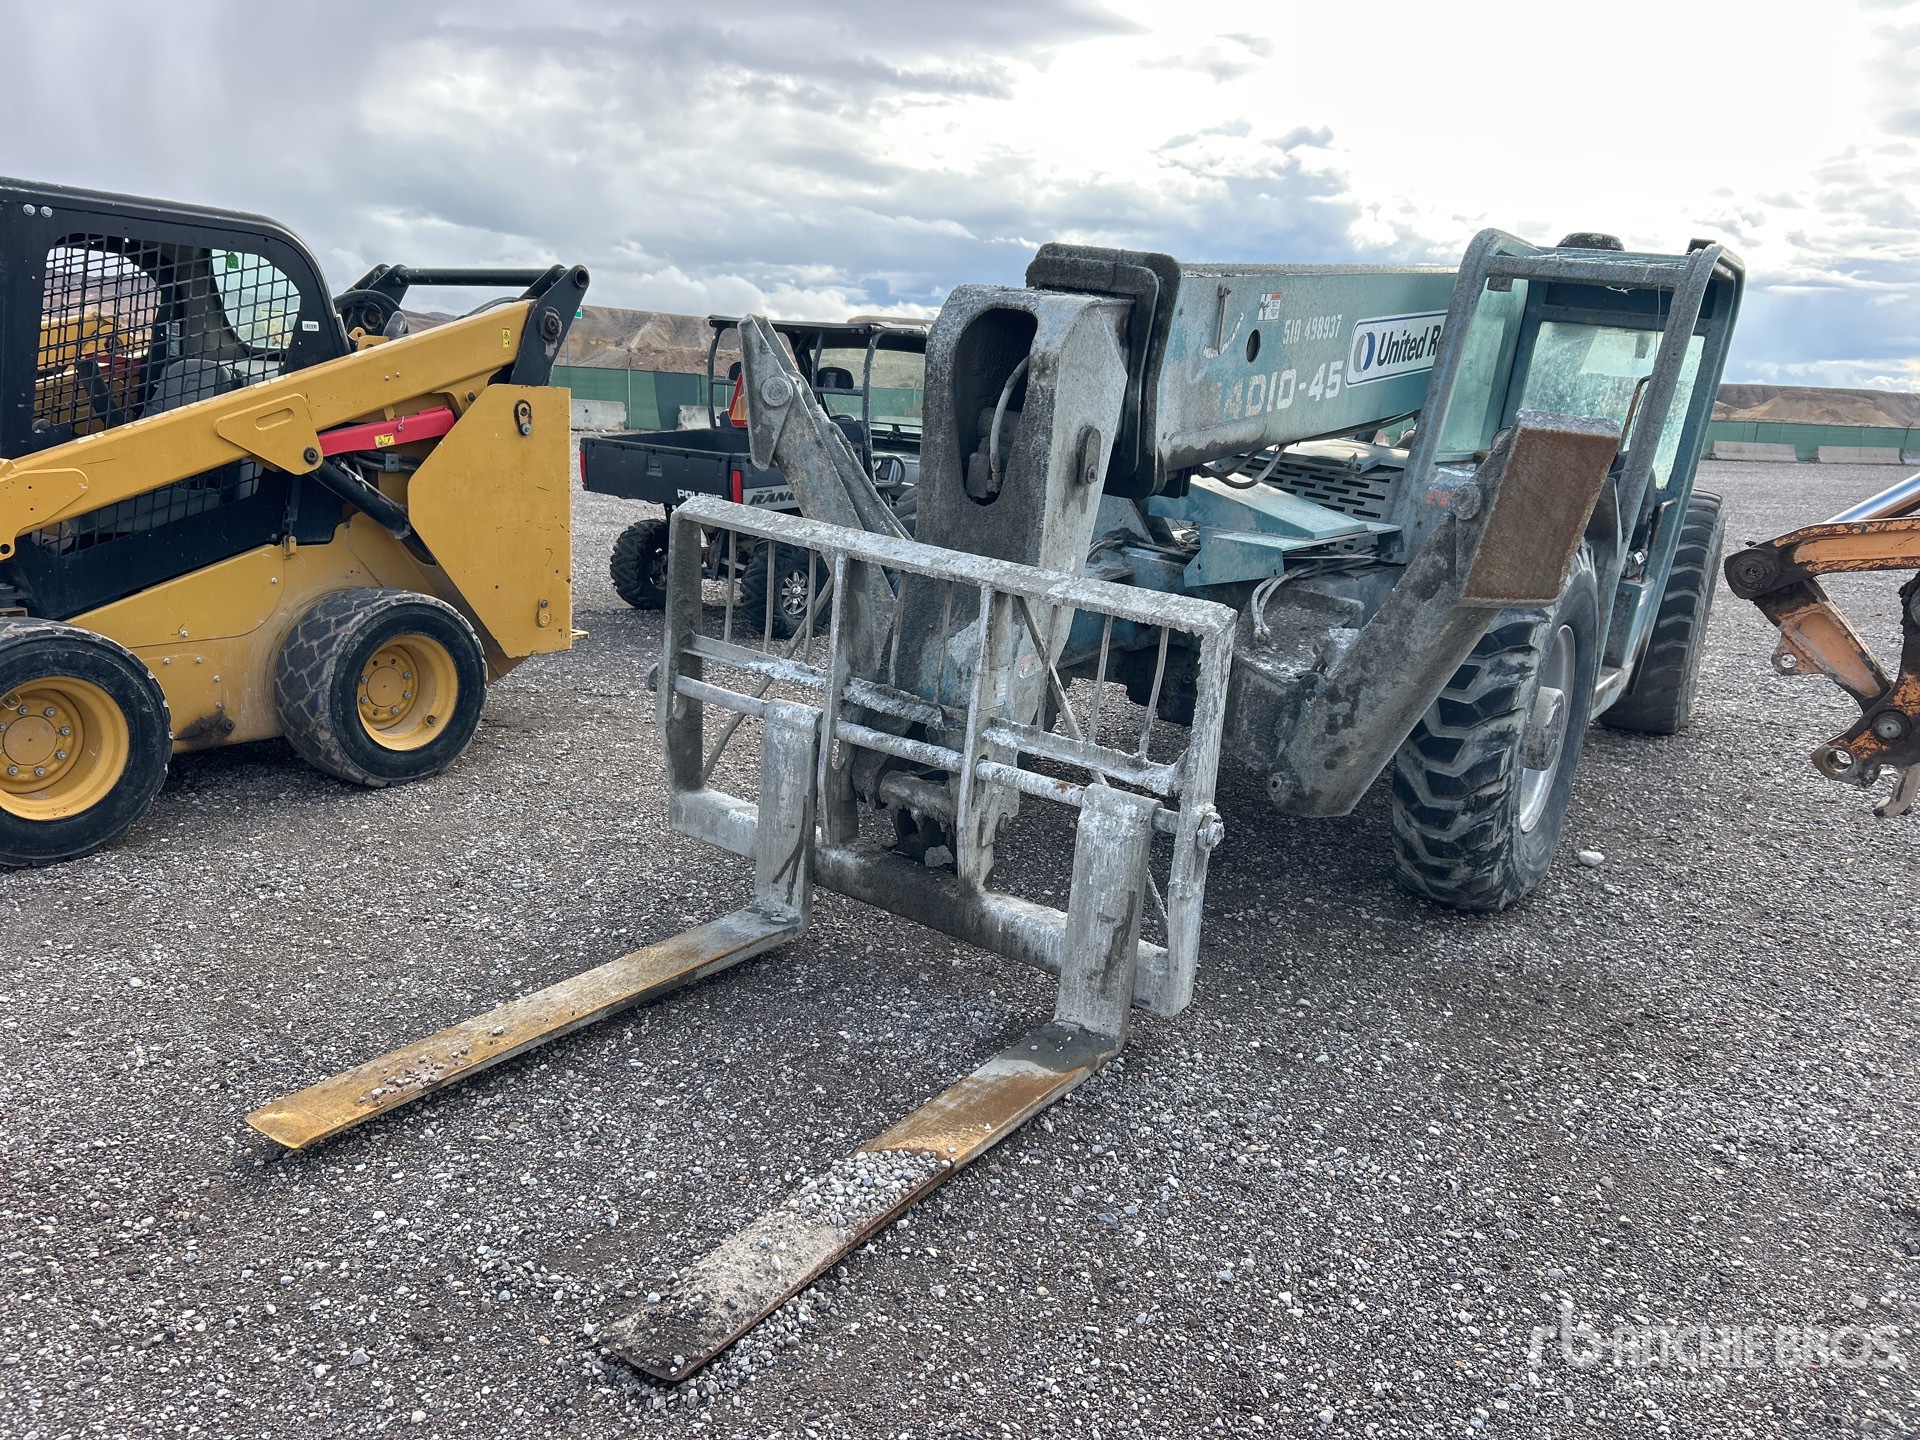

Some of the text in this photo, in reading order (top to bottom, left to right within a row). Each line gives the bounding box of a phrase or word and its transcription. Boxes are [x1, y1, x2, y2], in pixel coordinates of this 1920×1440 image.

[1282, 314, 1343, 345] 510 498937
[1376, 325, 1443, 367] United R
